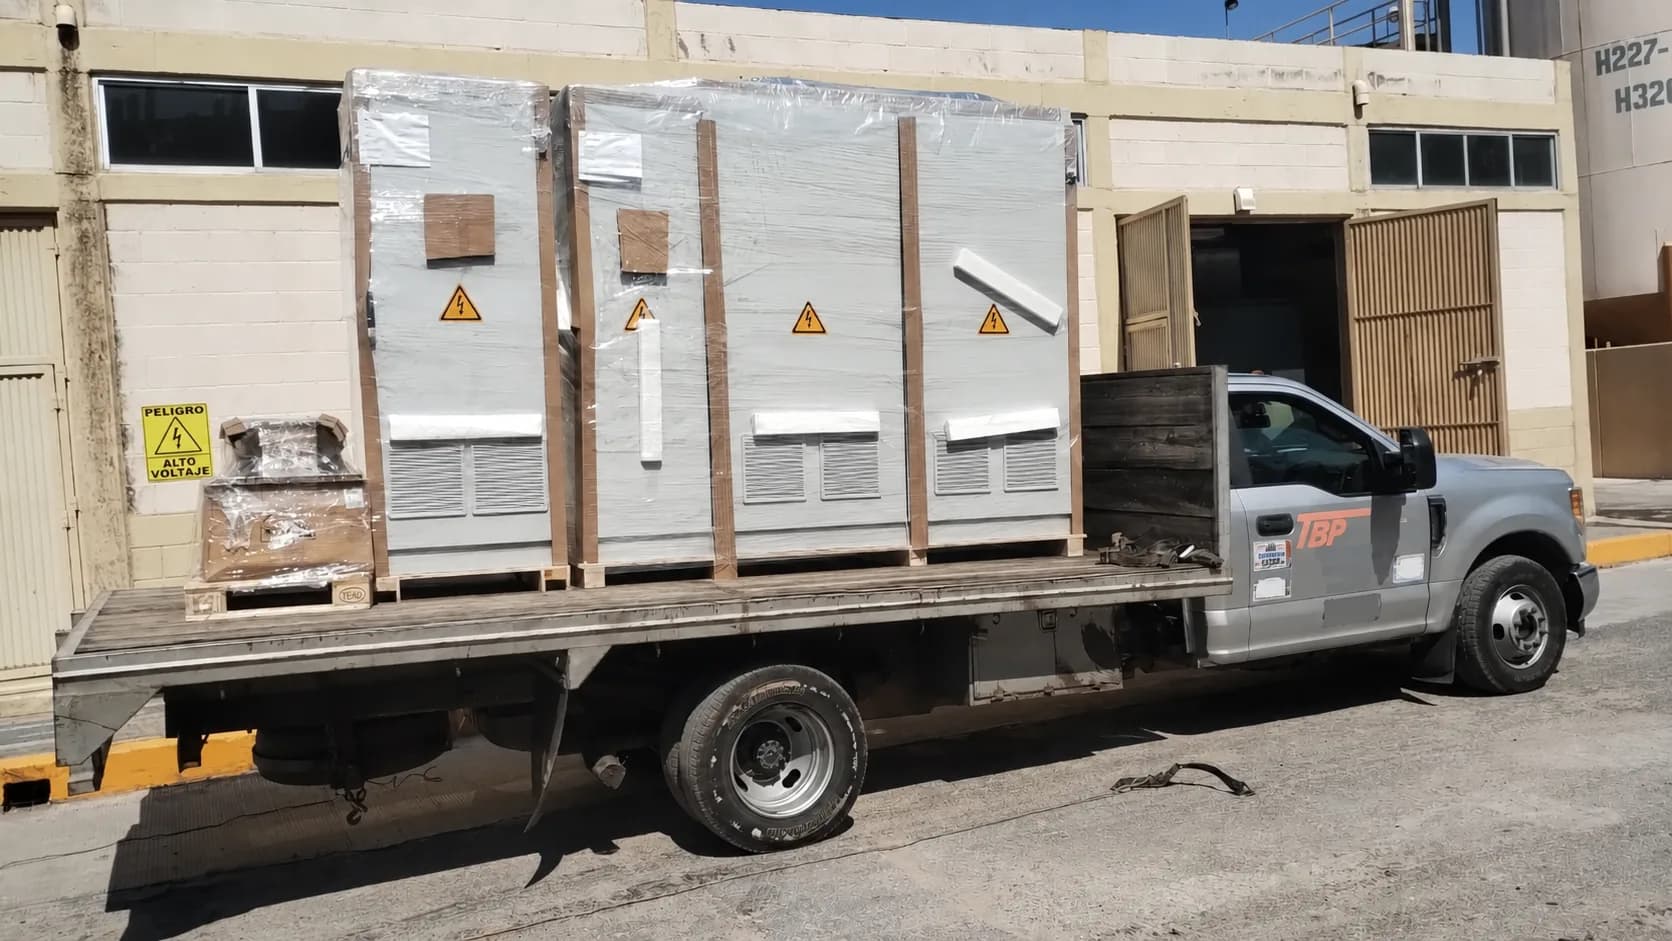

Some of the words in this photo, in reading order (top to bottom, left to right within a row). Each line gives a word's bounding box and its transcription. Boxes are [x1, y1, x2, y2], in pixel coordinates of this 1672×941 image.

[1595, 38, 1668, 76] H227-
[145, 406, 204, 417] PELIGRO
[163, 457, 196, 468] ALTO
[151, 466, 210, 478] VOLTAJE
[1296, 507, 1372, 550] TBP
